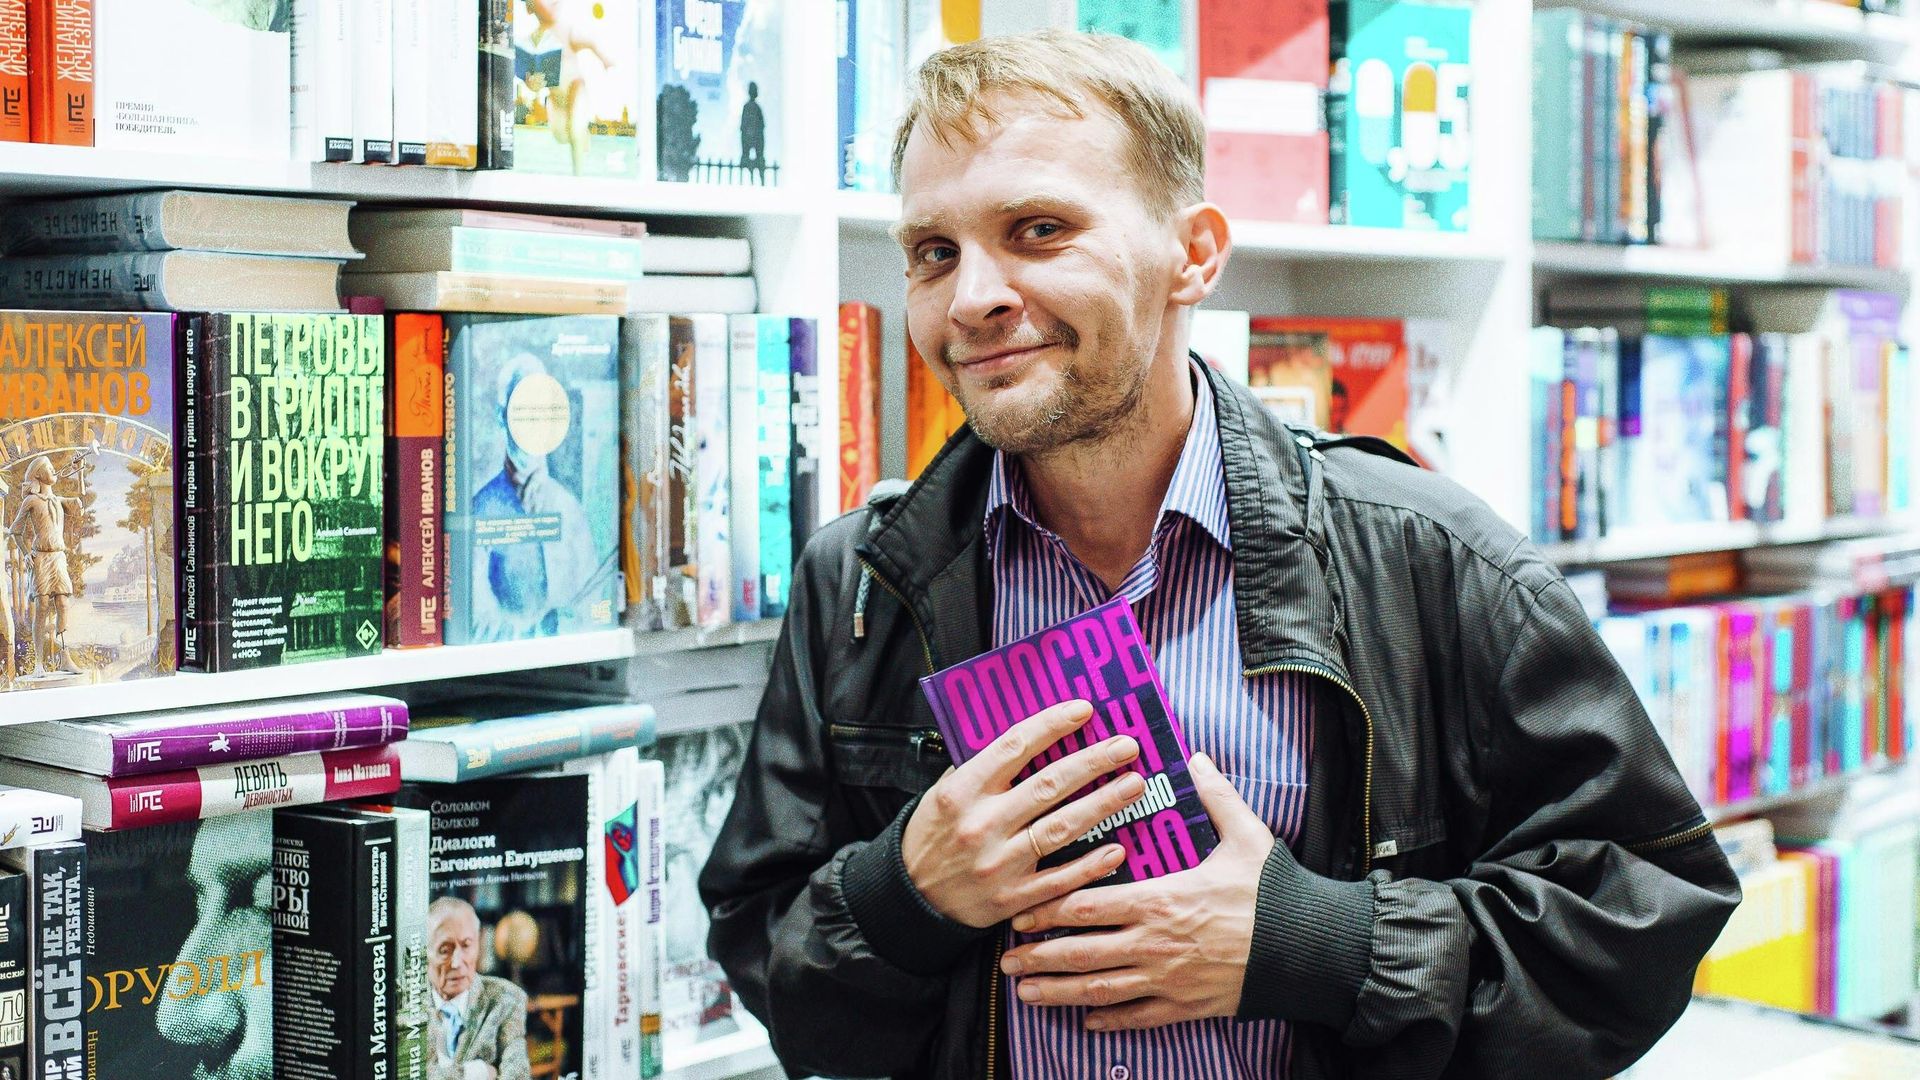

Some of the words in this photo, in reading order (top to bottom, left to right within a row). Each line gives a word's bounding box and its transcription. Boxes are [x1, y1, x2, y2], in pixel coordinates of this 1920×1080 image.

[115, 101, 154, 112] ПРЕМИЯ
[115, 122, 176, 134] ПОБЕДИТЕЛЬ
[45, 212, 117, 234] НЕНАСТЬЕ
[25, 269, 112, 289] НЕНАСТЬЕ
[0, 317, 146, 368] АЛЕКСЕЙ
[186, 329, 194, 354] него
[230, 314, 385, 375] ПЕТРОВЫ
[187, 357, 197, 395] вокруг
[187, 396, 195, 406] и
[230, 376, 252, 439] В
[261, 376, 385, 438] ГРИППЕ
[187, 410, 197, 448] гриппе
[186, 461, 197, 508] Петровы
[231, 440, 252, 502] И
[262, 437, 380, 501] ВОКРУГ
[420, 447, 434, 515] ИВАНОВ
[185, 515, 196, 573] Сальников
[231, 500, 314, 566] НЕГО
[419, 516, 435, 588] АЛЕКСЕЙ
[186, 575, 196, 620] Алексей
[234, 761, 288, 798] ДЕВЯТЬ
[333, 766, 351, 784] Анна
[353, 763, 392, 782] Матвеева
[243, 787, 294, 810] ДЕВЯНОСТЫХ
[430, 800, 490, 814] Соломон
[431, 816, 479, 831] Волков
[274, 851, 310, 869] ДНОЕ
[429, 854, 503, 874] Евгением
[504, 847, 584, 869] Евтушенко
[430, 834, 496, 854] Диалоги
[43, 866, 67, 920] ТАК,
[65, 861, 82, 956] РЕБЯТА...
[272, 885, 310, 914] РЫ
[86, 886, 95, 955] Недошивин
[43, 925, 63, 958] НЕ
[35, 960, 82, 1055] ВСЁ
[370, 942, 387, 1055] Матвеева
